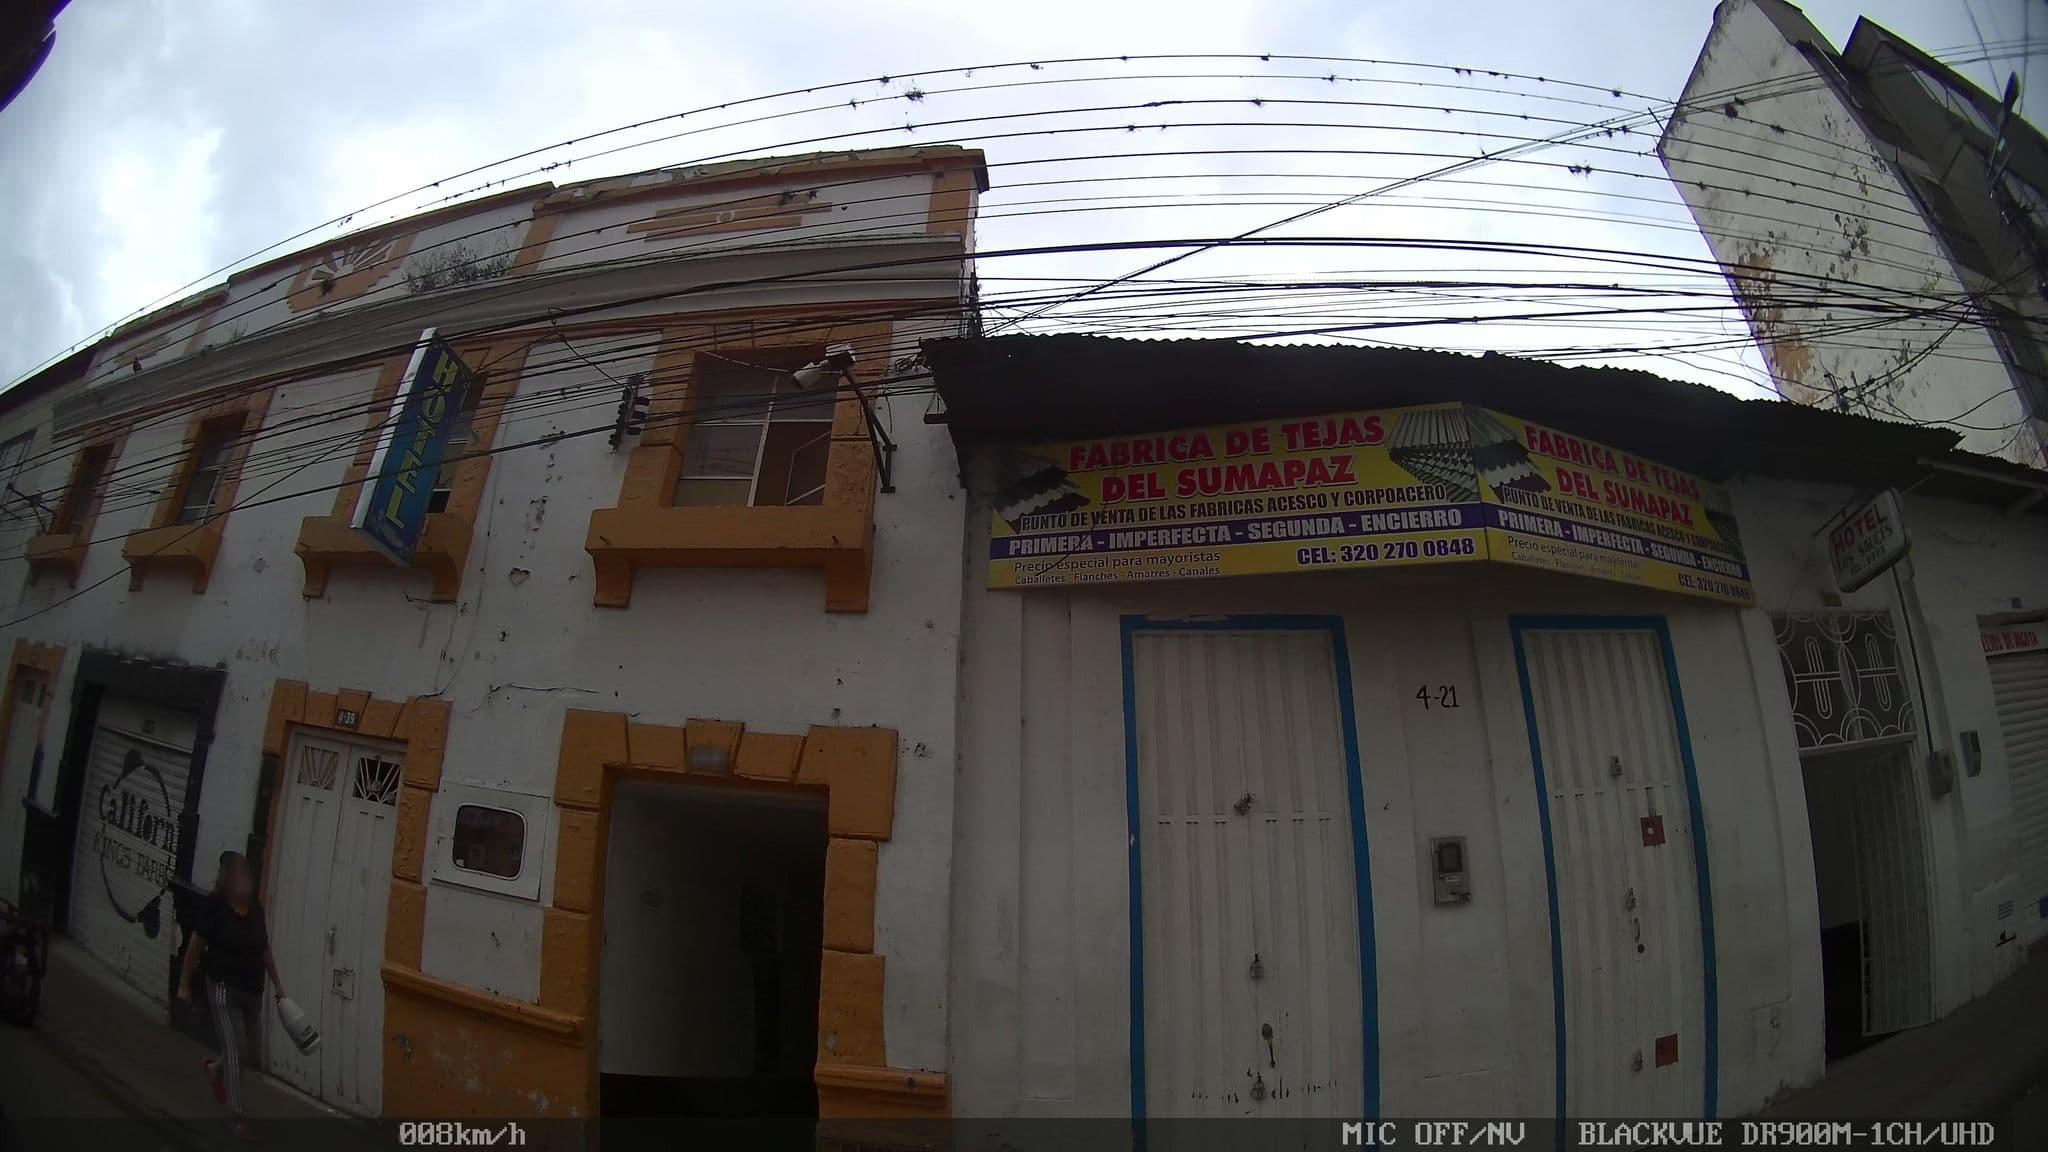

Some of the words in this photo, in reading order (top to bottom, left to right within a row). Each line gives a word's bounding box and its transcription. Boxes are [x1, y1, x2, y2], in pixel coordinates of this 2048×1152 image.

[386, 350, 459, 529] HOTEL
[1068, 433, 1216, 472] FABRICA
[1225, 425, 1271, 457] DE
[1282, 416, 1385, 450] TEJAS
[1525, 425, 1619, 474] FABRICA
[1622, 455, 1649, 484] DE
[1651, 463, 1700, 501] TEJAS
[1102, 473, 1167, 504] DEL
[1177, 455, 1357, 498] SUMAPAZ
[1555, 465, 1601, 502] DEL
[1603, 480, 1695, 529] SUMAPAZ
[1021, 513, 1067, 532] PUNTO
[1071, 511, 1087, 527] DE
[1092, 508, 1135, 526] VENTA
[1139, 507, 1156, 522] DE
[1160, 504, 1186, 520] LAS
[1190, 498, 1263, 518] FABRICAS
[1268, 492, 1327, 513] ACESCO
[1328, 491, 1339, 508] Y
[1344, 484, 1446, 507] CORPOACERO
[1504, 487, 1539, 509] PUNTO
[1541, 494, 1554, 512] DE
[1555, 499, 1586, 519] VENTA
[1587, 506, 1598, 521] DE
[1599, 508, 1616, 526] LAS
[1832, 504, 1887, 553] HOTEL
[1009, 535, 1093, 556] PRIMERA
[1109, 525, 1231, 549] IMPERFECTA
[1248, 516, 1345, 541] SEGUNDA
[1362, 508, 1462, 533] ENCIERRO
[1297, 548, 1337, 565] CEL:
[1340, 544, 1379, 563] 320
[1384, 541, 1418, 560] 270
[1423, 538, 1474, 557] 0848
[1498, 509, 1563, 538] PRIMERA
[1572, 525, 1645, 554] IMPERFECTA
[1508, 536, 1539, 551] Precio
[1014, 561, 1055, 573] Precio
[1057, 556, 1108, 571] especial
[1113, 555, 1142, 569] para
[1146, 551, 1221, 569] mayoristas
[1127, 568, 1170, 579] Amarres
[1178, 564, 1220, 577] Canales
[1416, 685, 1460, 709] 4-21
